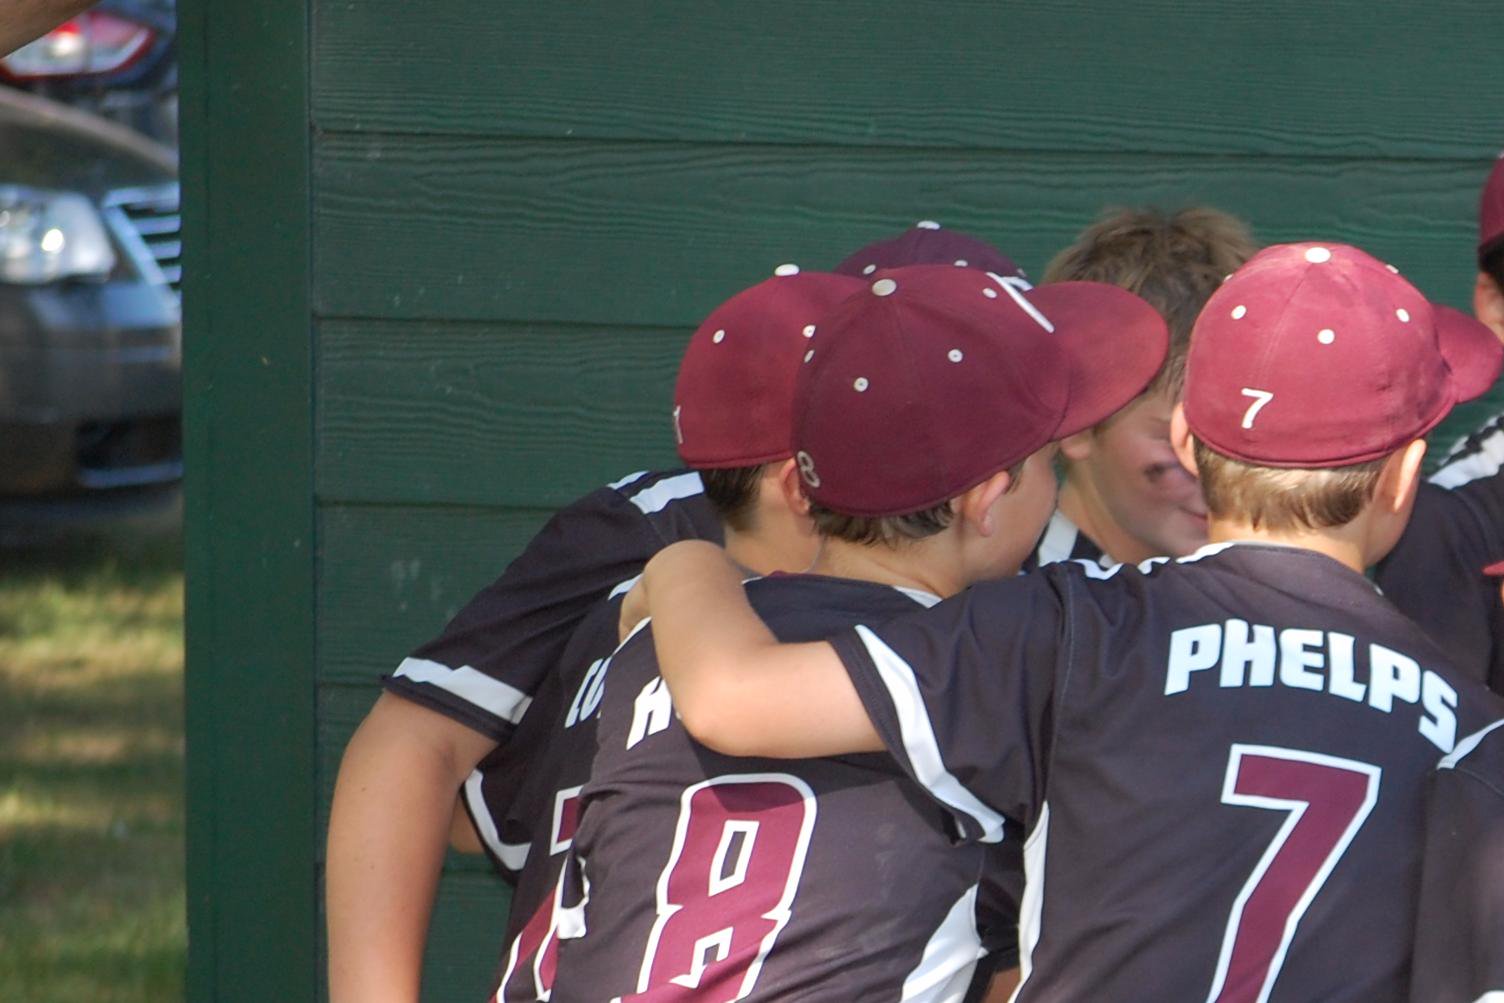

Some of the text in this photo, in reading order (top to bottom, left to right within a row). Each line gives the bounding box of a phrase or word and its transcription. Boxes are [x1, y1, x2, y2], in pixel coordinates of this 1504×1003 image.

[797, 450, 821, 488] 8
[1241, 387, 1274, 429] 7
[1164, 618, 1458, 754] PHELPS
[608, 773, 817, 1003] 8
[1206, 743, 1382, 1003] 7
